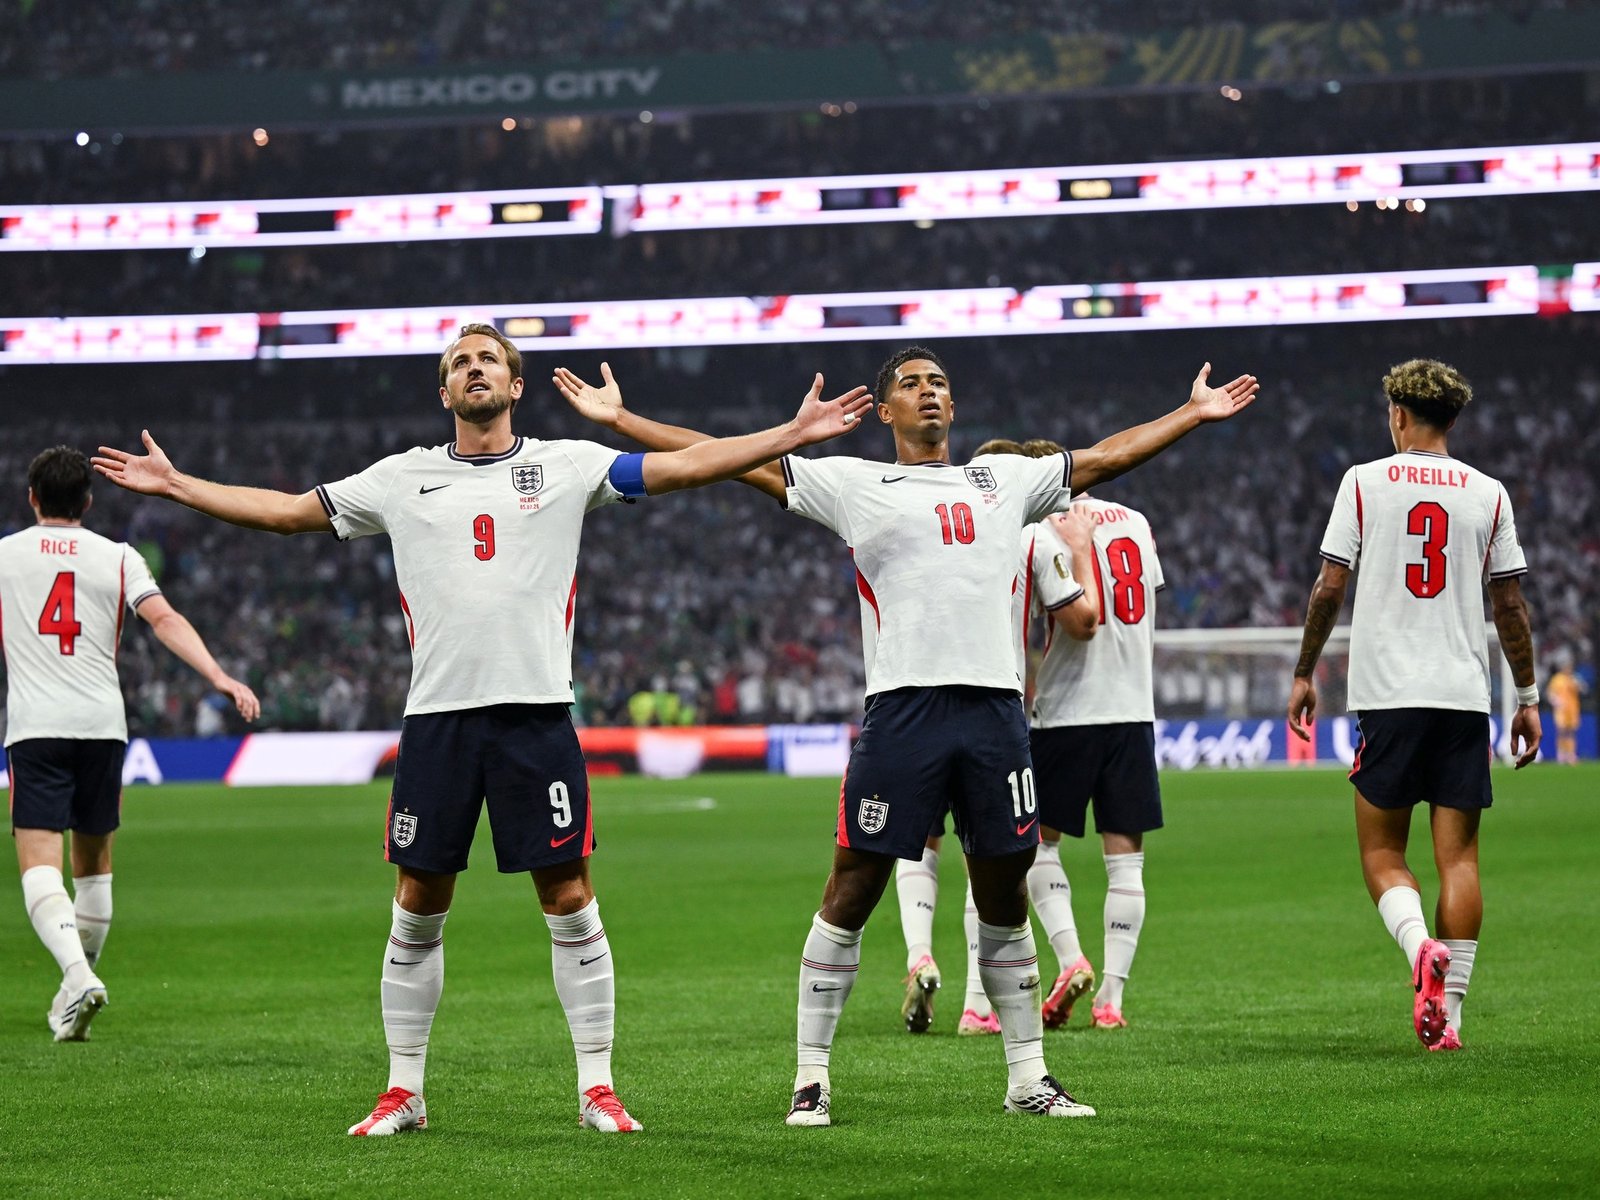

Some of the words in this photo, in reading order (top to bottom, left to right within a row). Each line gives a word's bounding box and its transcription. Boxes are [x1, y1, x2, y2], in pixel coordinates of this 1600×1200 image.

[343, 73, 536, 109] MEXICO
[544, 67, 660, 99] CITY
[1388, 465, 1469, 488] O'REILLY
[473, 514, 496, 561] 9
[935, 502, 976, 545] 10
[40, 538, 78, 555] RICE
[1405, 501, 1449, 599] 3
[38, 571, 82, 656] 4
[548, 780, 573, 829] 9
[1007, 767, 1036, 818] 10
[1110, 921, 1132, 931] ENG
